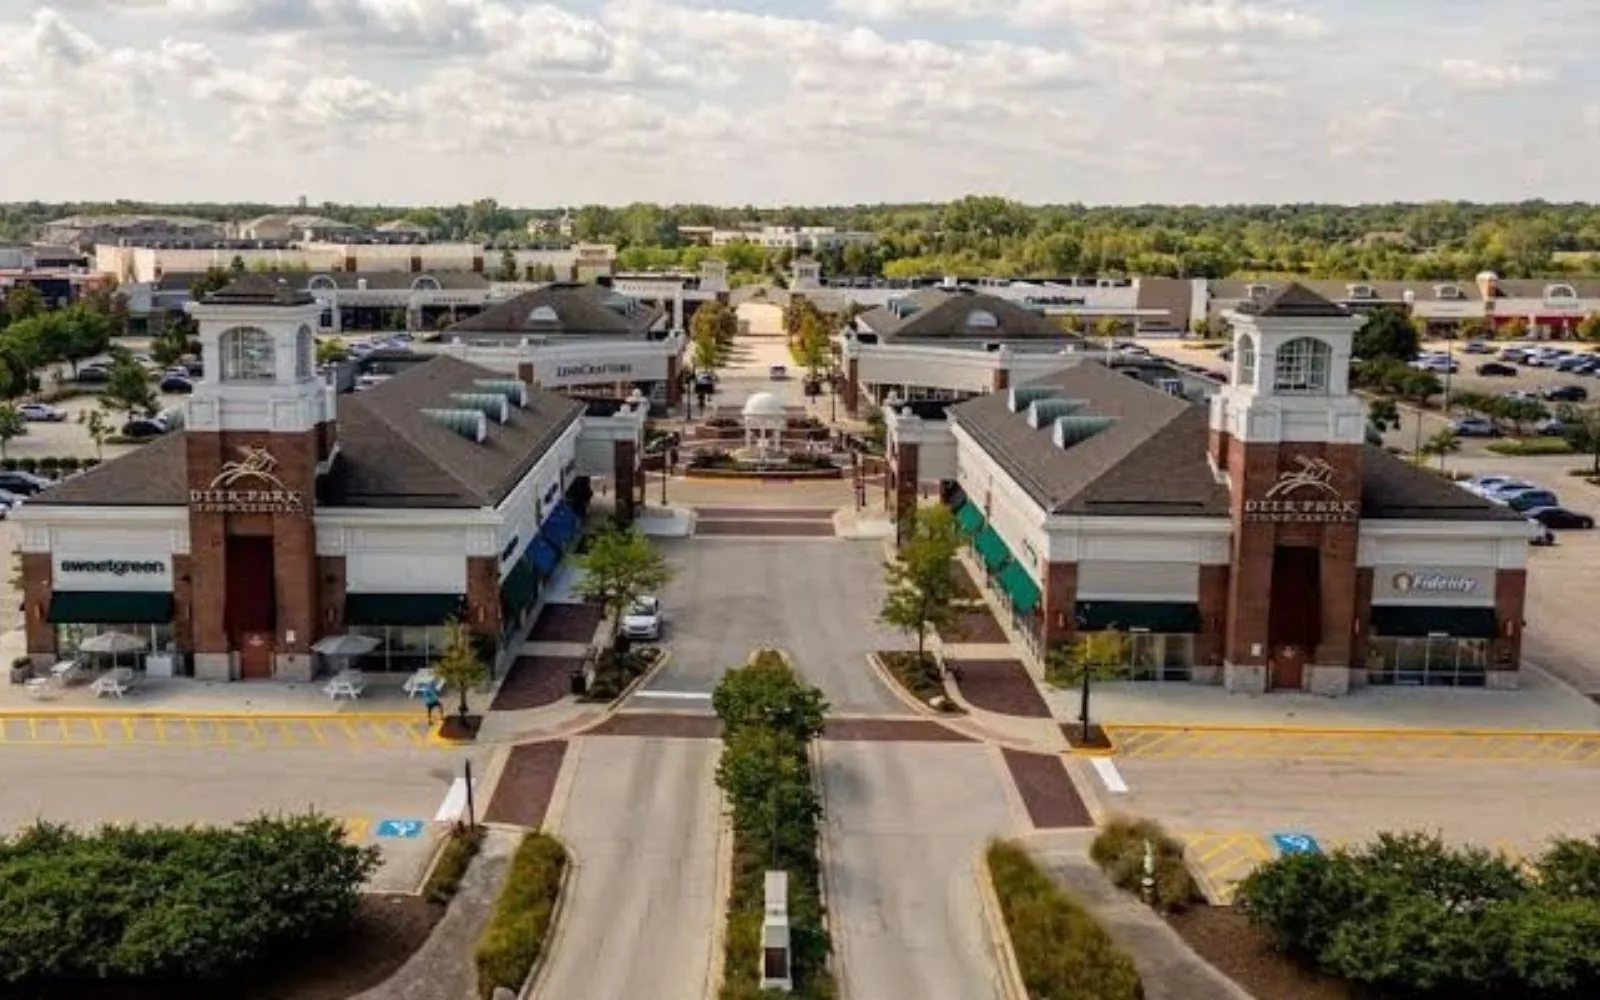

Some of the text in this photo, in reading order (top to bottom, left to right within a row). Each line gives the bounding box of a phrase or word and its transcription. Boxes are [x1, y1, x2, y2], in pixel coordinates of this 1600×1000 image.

[247, 490, 301, 504] PARK
[1302, 500, 1358, 514] PARK
[61, 559, 165, 576] sweetgreen
